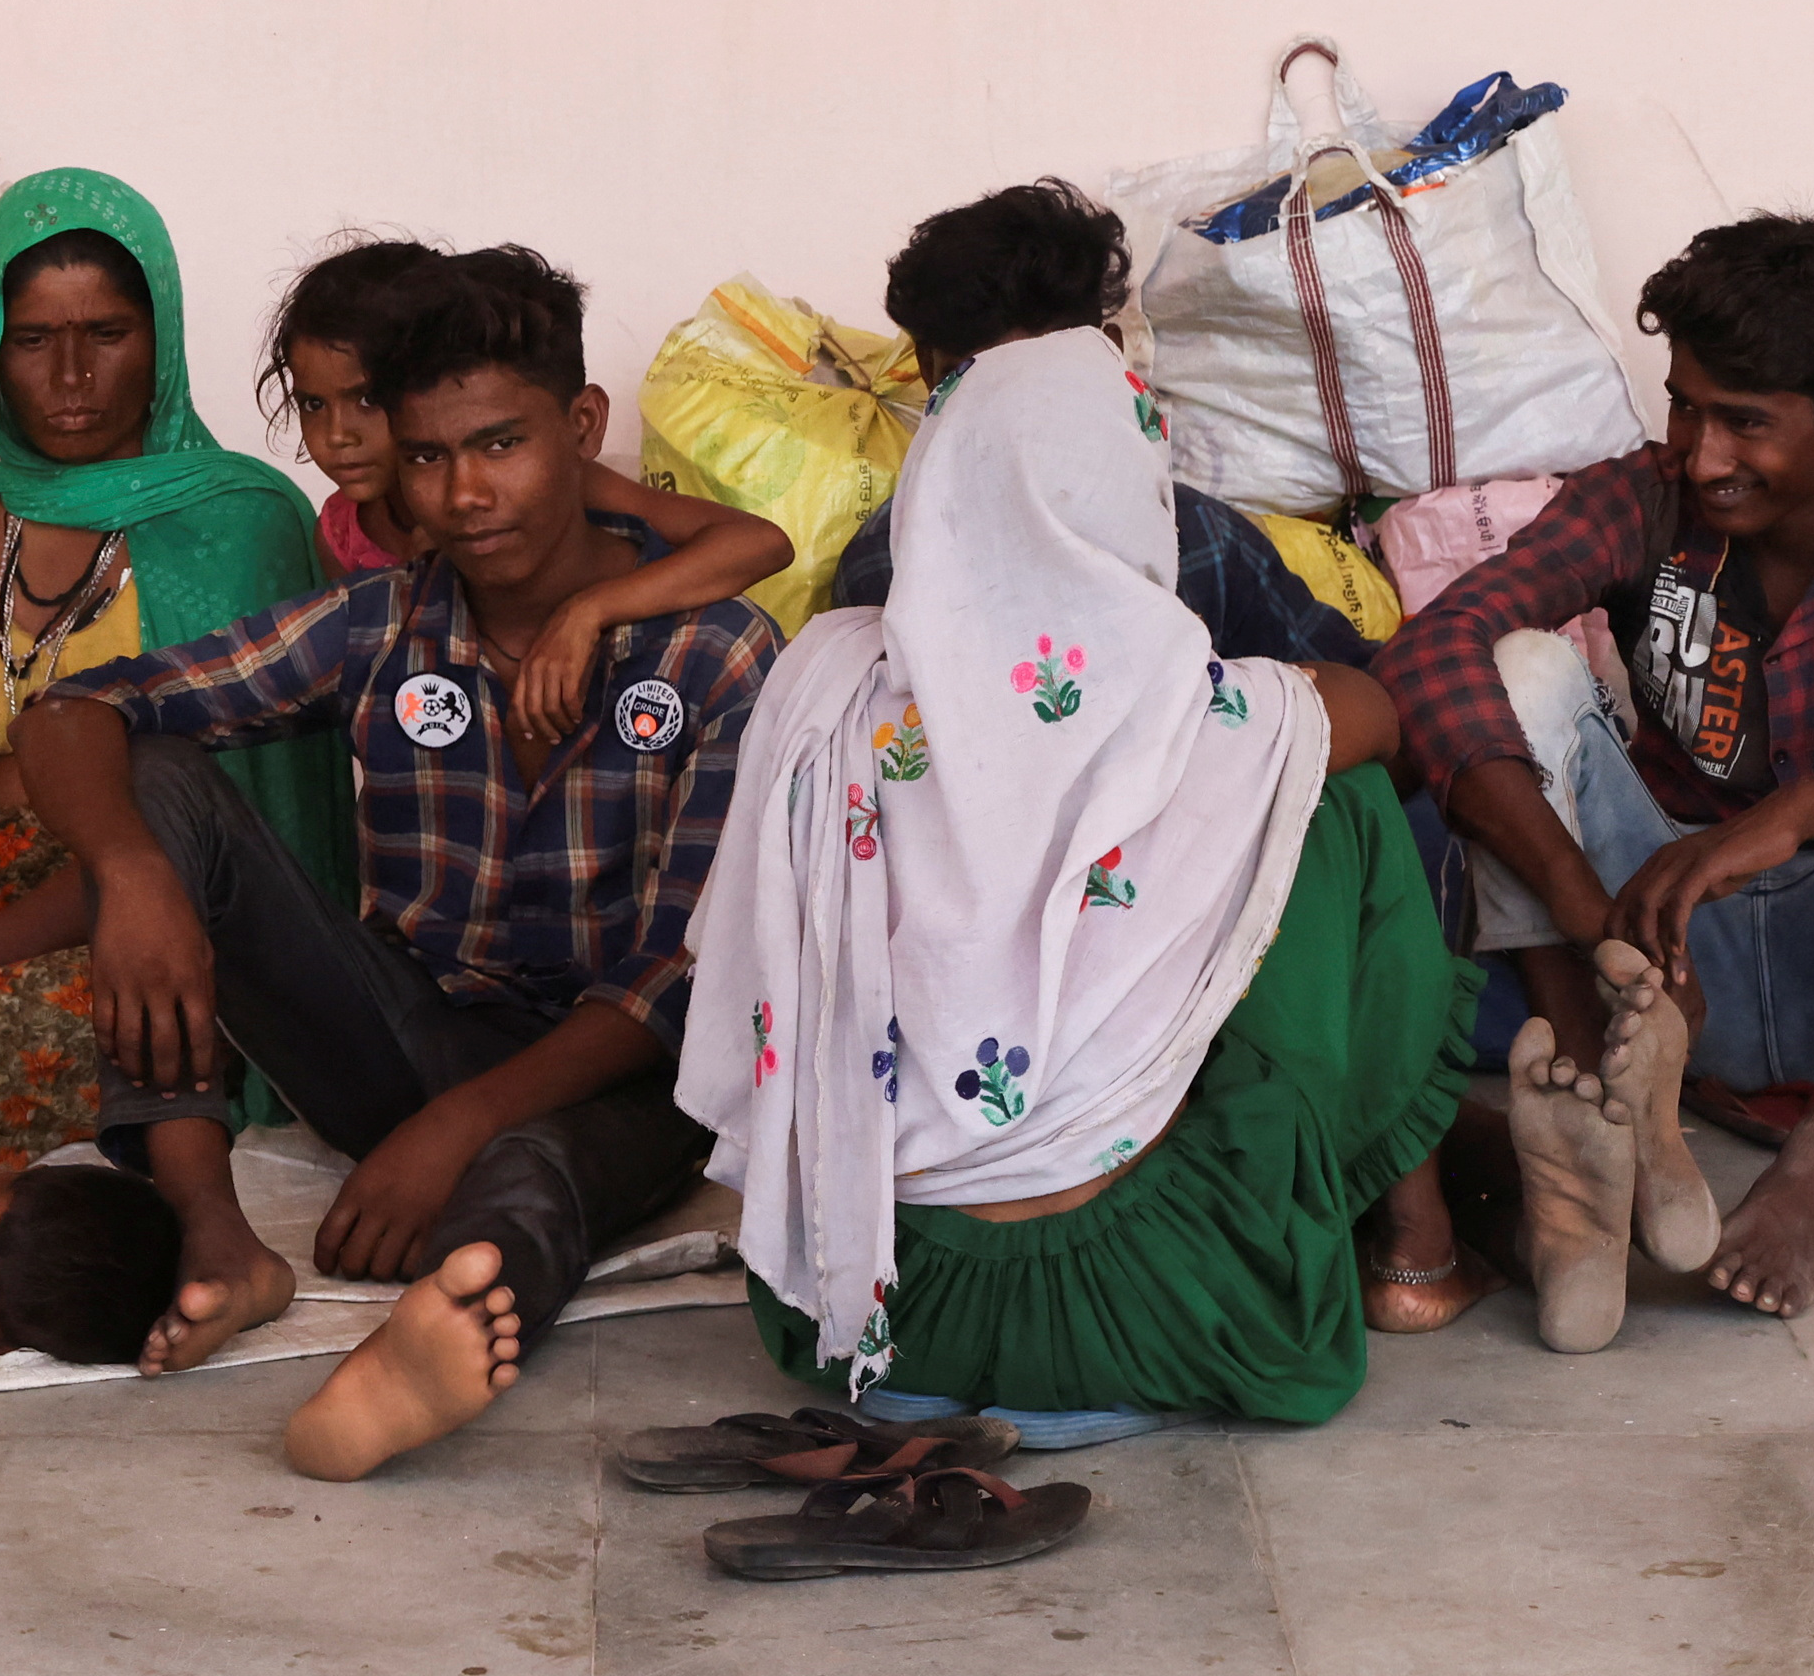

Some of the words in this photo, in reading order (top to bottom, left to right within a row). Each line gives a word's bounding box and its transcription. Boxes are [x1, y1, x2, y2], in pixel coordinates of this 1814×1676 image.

[1693, 604, 1751, 760] ASTER
[637, 683, 674, 701] LIMITED
[633, 702, 665, 719] GRADE
[637, 717, 652, 735] A
[1693, 755, 1726, 775] ARMENT
